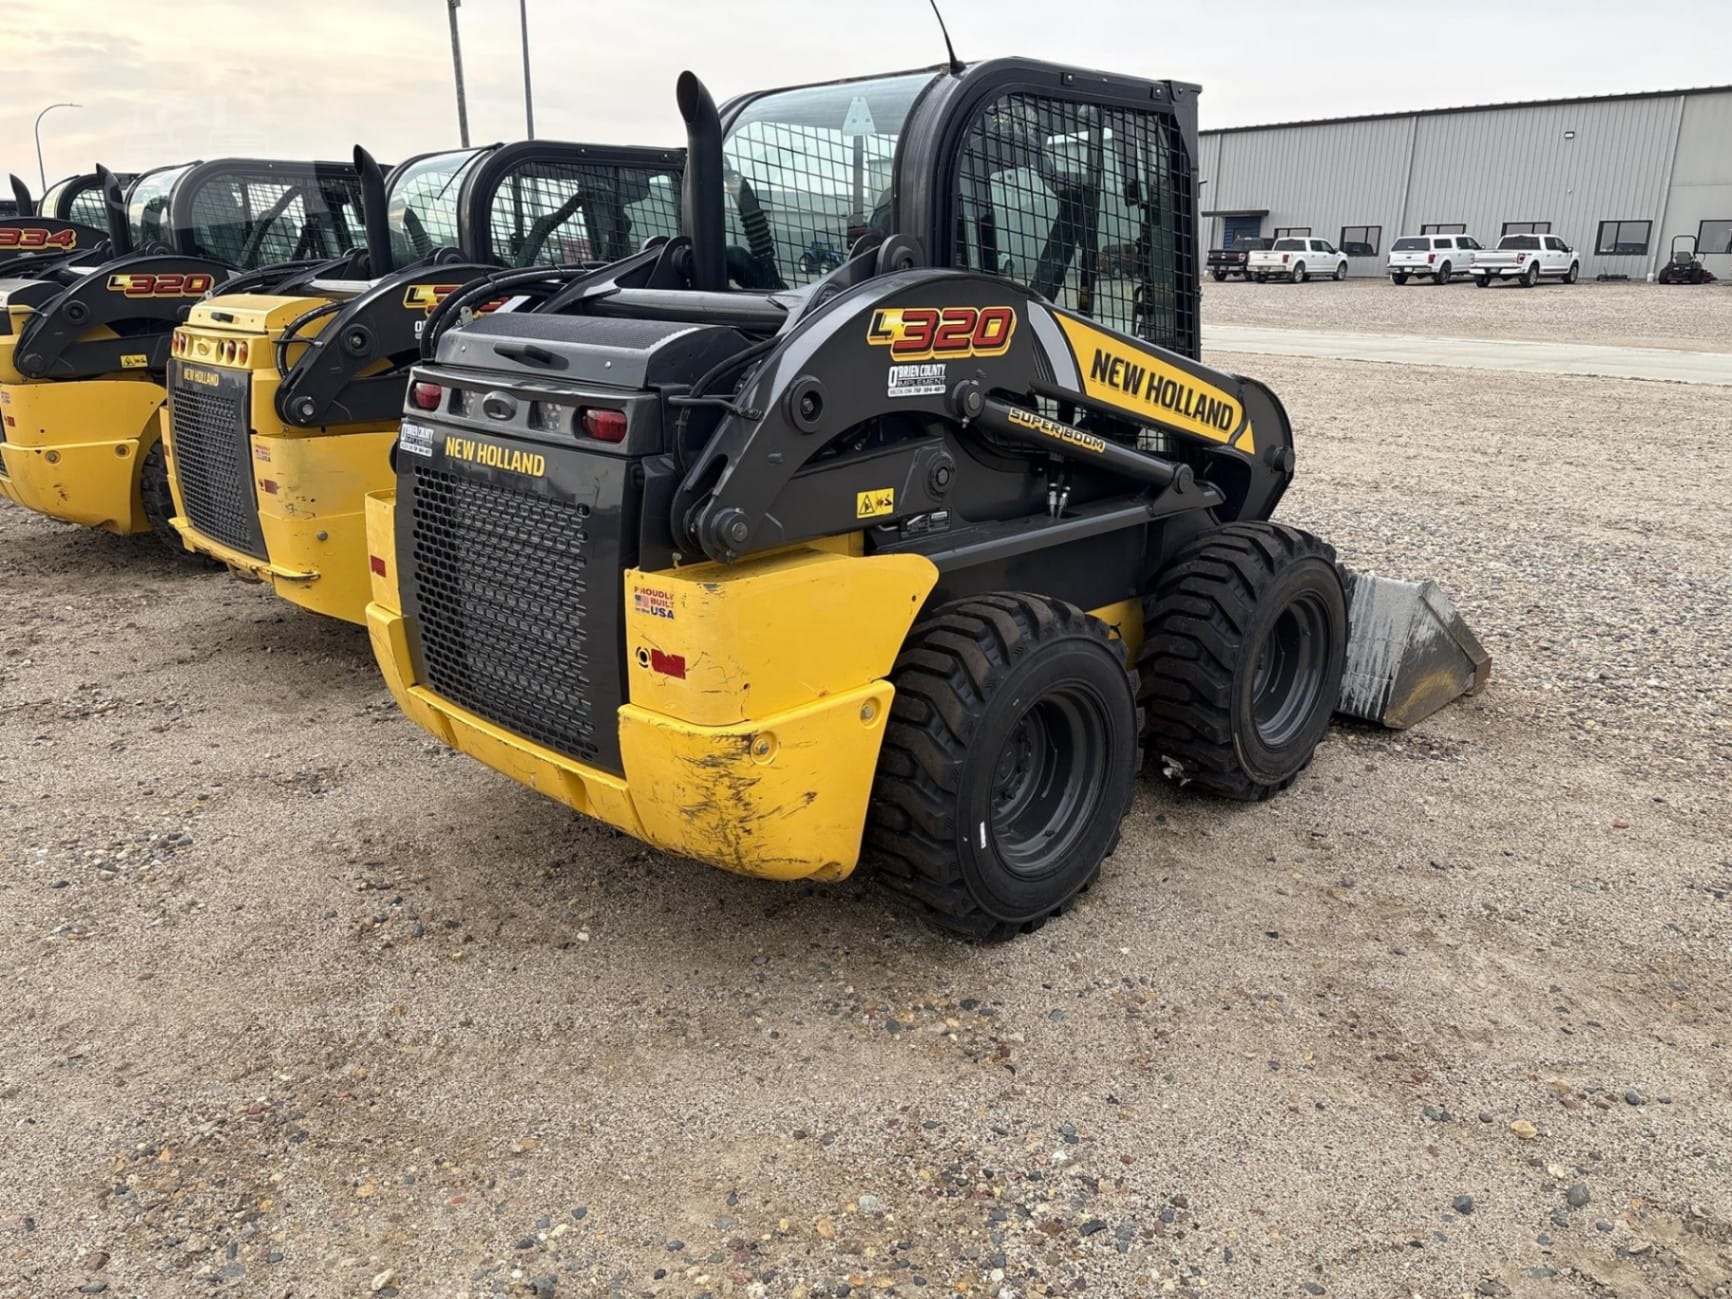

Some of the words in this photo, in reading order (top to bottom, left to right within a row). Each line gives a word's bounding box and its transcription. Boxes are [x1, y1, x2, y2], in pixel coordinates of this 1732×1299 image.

[106, 274, 215, 298] L320
[867, 306, 1017, 361] L320
[920, 363, 947, 377] COUNTY
[1092, 348, 1143, 394] NEW
[1145, 371, 1234, 431] HOLLAND
[1008, 407, 1062, 438] SUPER
[1062, 426, 1106, 453] BOOM
[445, 436, 475, 461] NEW
[477, 442, 545, 477] HOLLAND
[650, 606, 675, 620] USA
